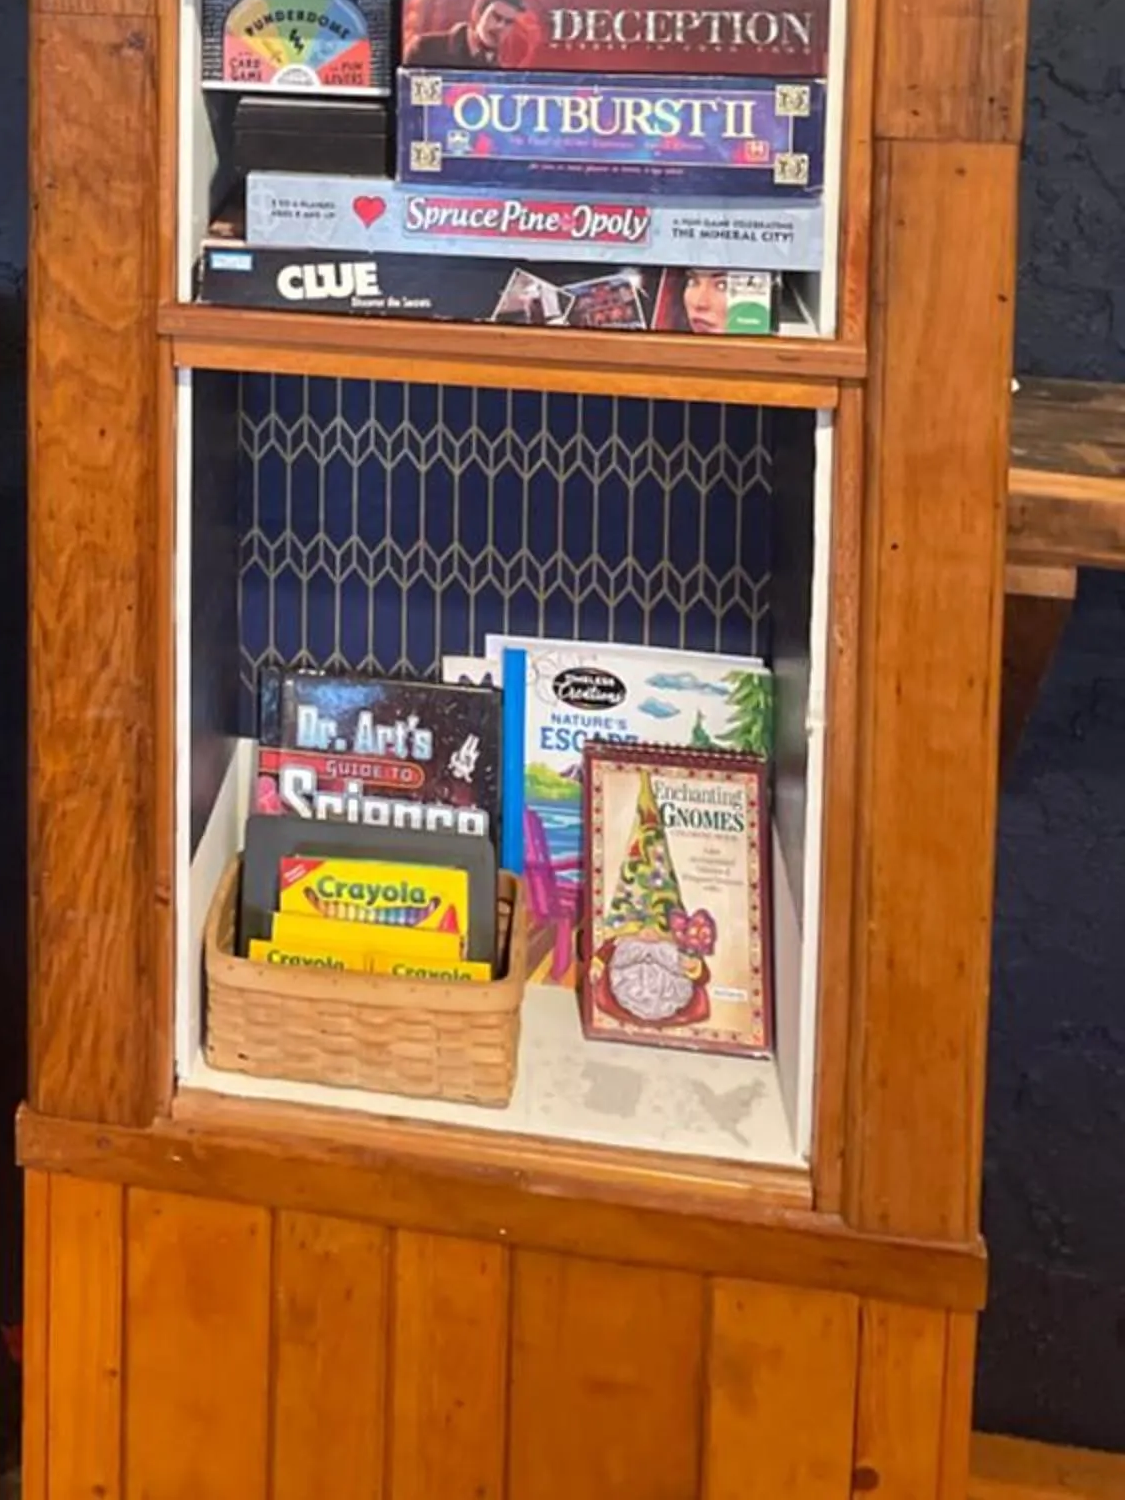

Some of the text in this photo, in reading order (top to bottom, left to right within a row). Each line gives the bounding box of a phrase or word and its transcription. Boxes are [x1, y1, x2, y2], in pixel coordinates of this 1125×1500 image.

[244, 9, 351, 39] PUNDERDOME
[550, 9, 813, 46] DECEPTION
[229, 58, 261, 69] CARD
[230, 70, 262, 82] GAME
[453, 91, 757, 138] OUTBURST II
[406, 198, 650, 239] Spruce Pine Opoly
[672, 228, 694, 238] THE
[700, 230, 757, 241] MINERAL
[277, 262, 382, 300] CLUE
[296, 704, 433, 761] Dr. Art's
[551, 713, 628, 730] NATURE'S
[325, 758, 413, 781] GUIDE TO
[654, 780, 743, 811] Enchanting
[316, 875, 426, 906] Crayola
[266, 949, 346, 972] Crayola
